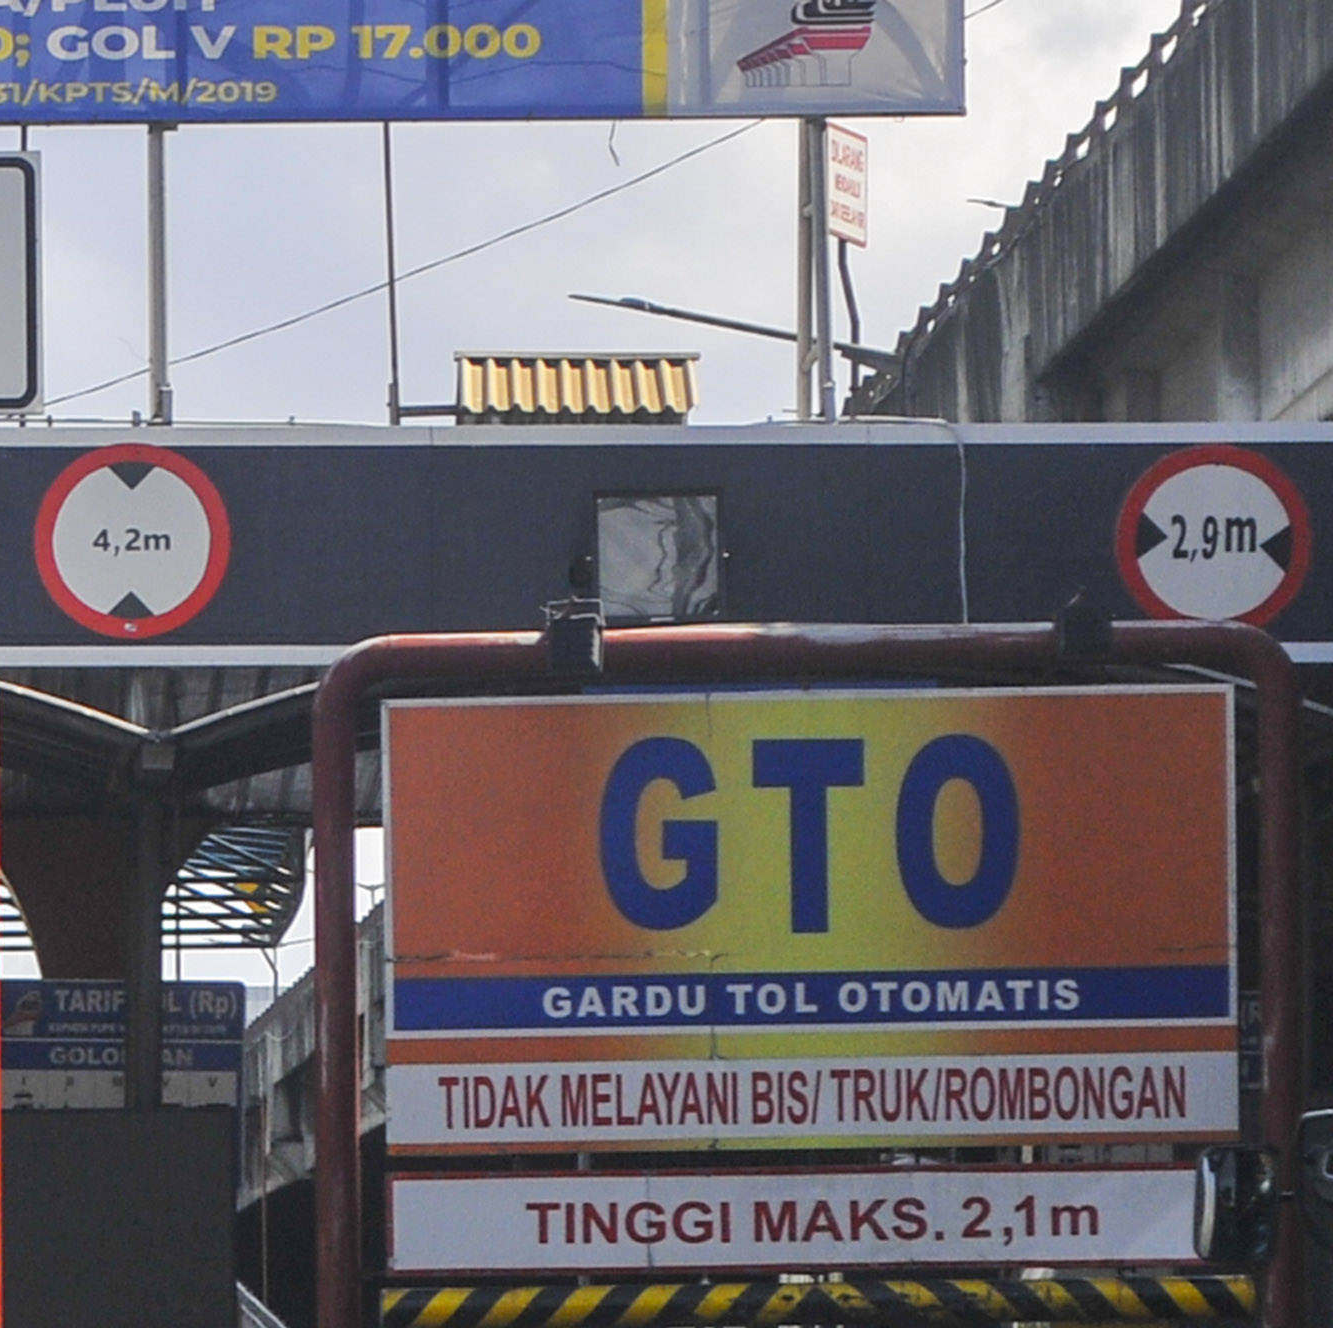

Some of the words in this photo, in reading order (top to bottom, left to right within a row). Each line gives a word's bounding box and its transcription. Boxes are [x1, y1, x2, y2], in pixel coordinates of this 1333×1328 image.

[45, 25, 175, 60] GOL
[190, 25, 239, 58] V
[251, 25, 335, 59] RP
[351, 24, 541, 59] 17.000
[92, 528, 172, 557] 4,2m
[1170, 514, 1258, 563] 2,9m
[598, 732, 1021, 935] GTO
[542, 984, 708, 1019] GARDU
[726, 982, 818, 1016] TOL
[838, 979, 1081, 1015] OTOMATIS
[437, 1074, 550, 1131] TIDAK
[560, 1072, 738, 1128] MELAYANI
[830, 1065, 1187, 1125] TRUK/ROMBONGAN
[525, 1201, 732, 1246] TINGGI
[752, 1199, 945, 1244] MAKS.
